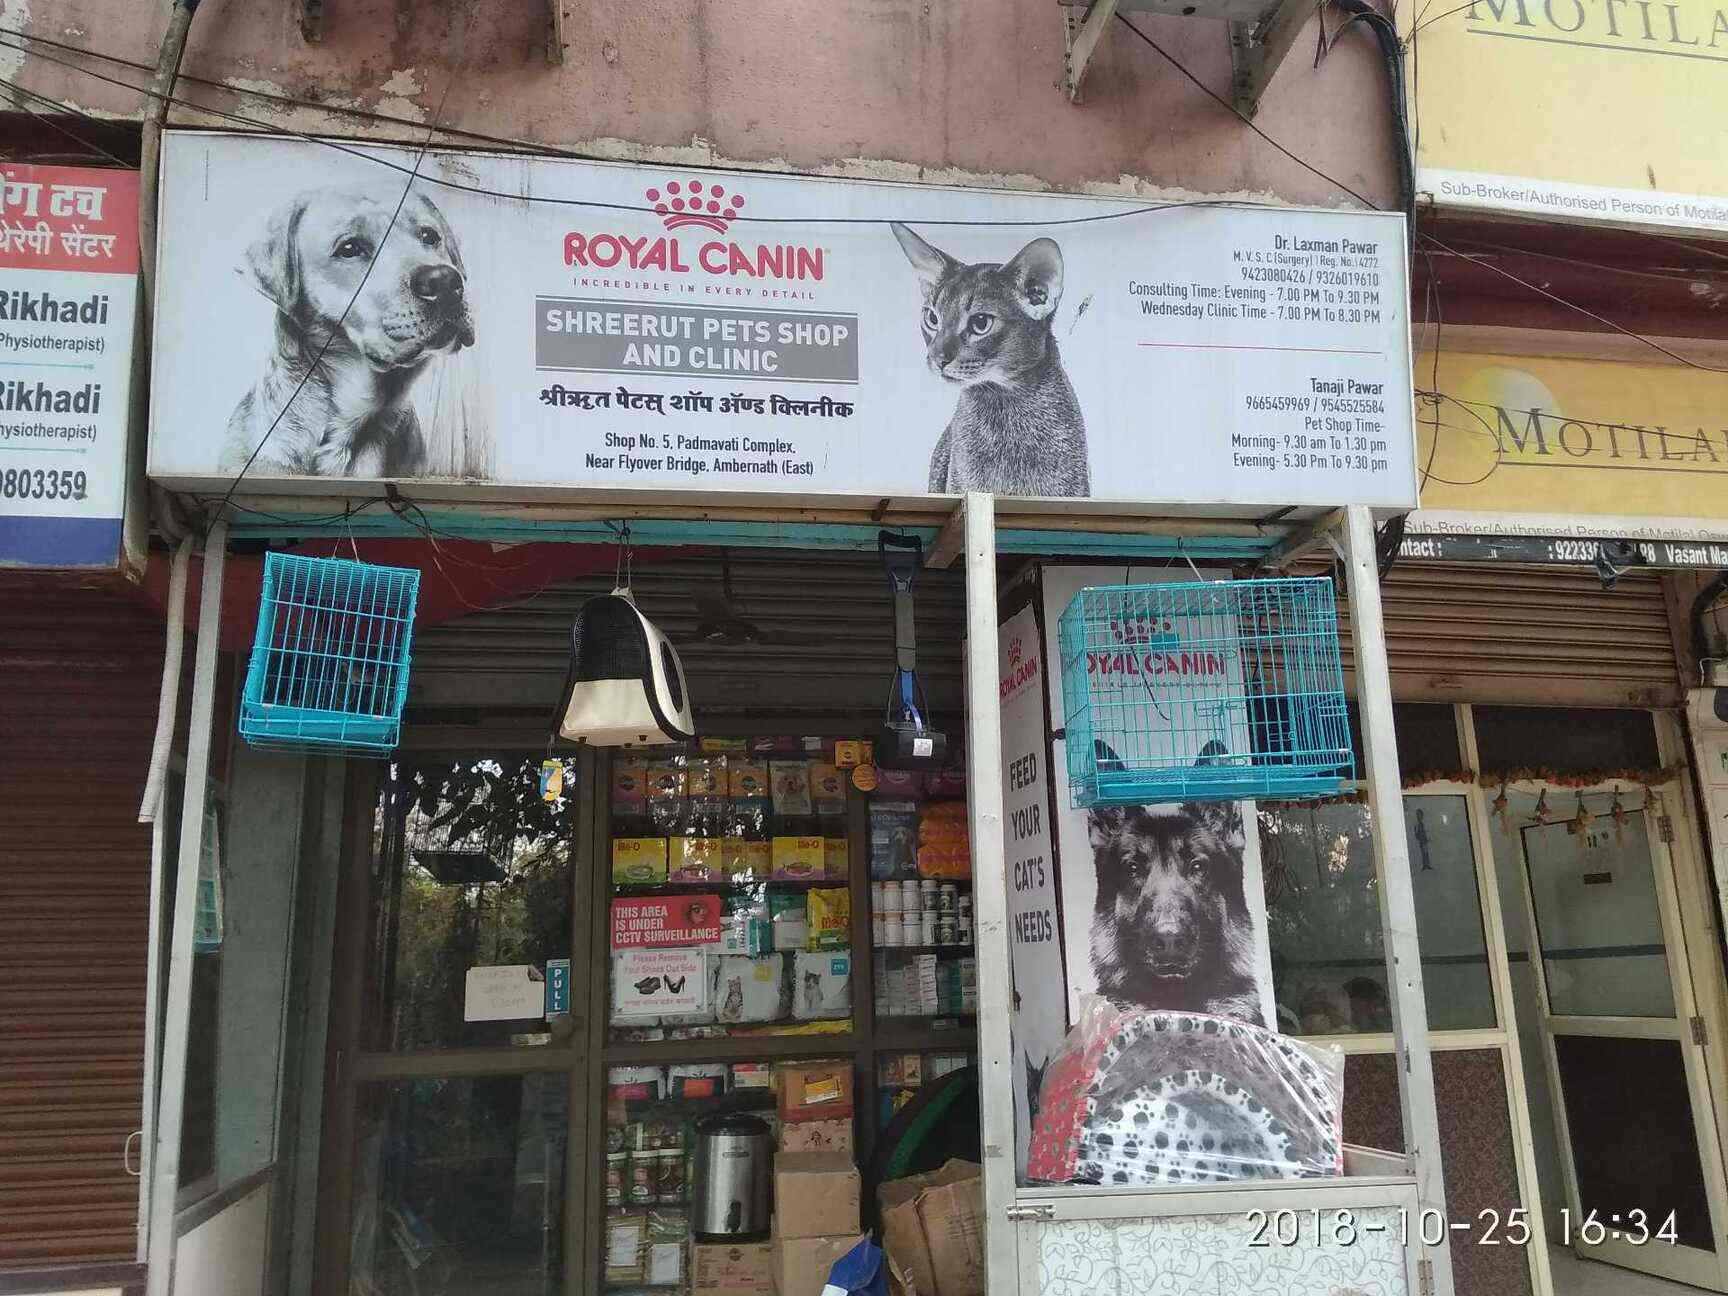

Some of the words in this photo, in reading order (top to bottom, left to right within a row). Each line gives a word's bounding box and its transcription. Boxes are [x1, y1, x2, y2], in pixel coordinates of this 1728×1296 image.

[50, 184, 107, 220] टच
[1441, 181, 1606, 211] Sub-Broker/Authorised
[1611, 199, 1662, 215] Person
[1667, 203, 1681, 216] of
[60, 223, 117, 258] सेंटर
[1274, 234, 1290, 250] Dr.
[1293, 236, 1339, 253] Laxman
[1342, 239, 1379, 255] Pawar
[563, 232, 690, 273] ROYAL
[699, 242, 824, 281] CANIN
[1241, 267, 1305, 283] 9423080426
[1316, 271, 1379, 286] 9326019610
[573, 277, 670, 292] INCREDIBLE
[680, 284, 695, 293] IN
[705, 286, 752, 297] EVERY
[762, 289, 815, 300] DETAIL
[1129, 280, 1188, 300] Consulting
[1191, 284, 1221, 298] Time:
[1224, 285, 1266, 303] Evening
[1277, 287, 1300, 302] 7.00
[1304, 288, 1320, 302] PM
[1323, 289, 1335, 303] To
[1338, 290, 1360, 304] 9.30
[1363, 291, 1379, 305] PM
[1141, 300, 1204, 320] Wednesday
[1207, 303, 1238, 318] Clinic
[1240, 304, 1267, 319] Time
[1278, 306, 1301, 320] 7.00
[1304, 307, 1320, 321] PM
[1323, 308, 1335, 322] To
[1338, 309, 1361, 323] 8.30
[1364, 309, 1381, 323] PM
[546, 309, 696, 340] SHREERUT
[703, 321, 771, 344] PETS
[777, 323, 849, 347] SHOP
[622, 343, 682, 369] AND
[688, 346, 779, 372] CLINIC
[1310, 378, 1344, 397] Tanaji
[1347, 379, 1384, 395] Pawar
[670, 390, 714, 412] शॉप
[1246, 396, 1310, 411] 9665459969
[1321, 398, 1385, 414] 9545525584
[1305, 416, 1323, 431] Pet
[1325, 417, 1352, 434] Shop
[605, 432, 636, 450] Shop
[639, 434, 659, 449] No.
[677, 435, 739, 451] Padmavati
[1284, 435, 1306, 449] 9.30
[1310, 438, 1326, 450] am
[1329, 436, 1341, 450] To
[1344, 437, 1367, 451] 1.30
[1370, 441, 1387, 454] pm
[585, 453, 615, 469] Near
[618, 455, 663, 472] Flyover
[713, 458, 778, 474] Ambernath
[782, 459, 814, 475] (East)
[1284, 454, 1307, 468] 5.30
[1310, 455, 1328, 469] Pm
[1330, 455, 1342, 469] To
[1345, 455, 1368, 470] 9.30
[1371, 458, 1388, 473] pm
[1664, 543, 1708, 564] Vasant
[1009, 753, 1037, 792] FEED
[1012, 803, 1041, 841] YOUR
[1014, 856, 1045, 892] CAT'S
[616, 907, 638, 918] THIS
[641, 905, 668, 917] AREA
[616, 920, 626, 931] IS
[629, 918, 663, 930] UNDER
[616, 931, 642, 943] CCTV
[644, 927, 719, 942] SURVEILLANCE
[1015, 910, 1052, 944] NEEDS
[553, 967, 563, 1011] PULL
